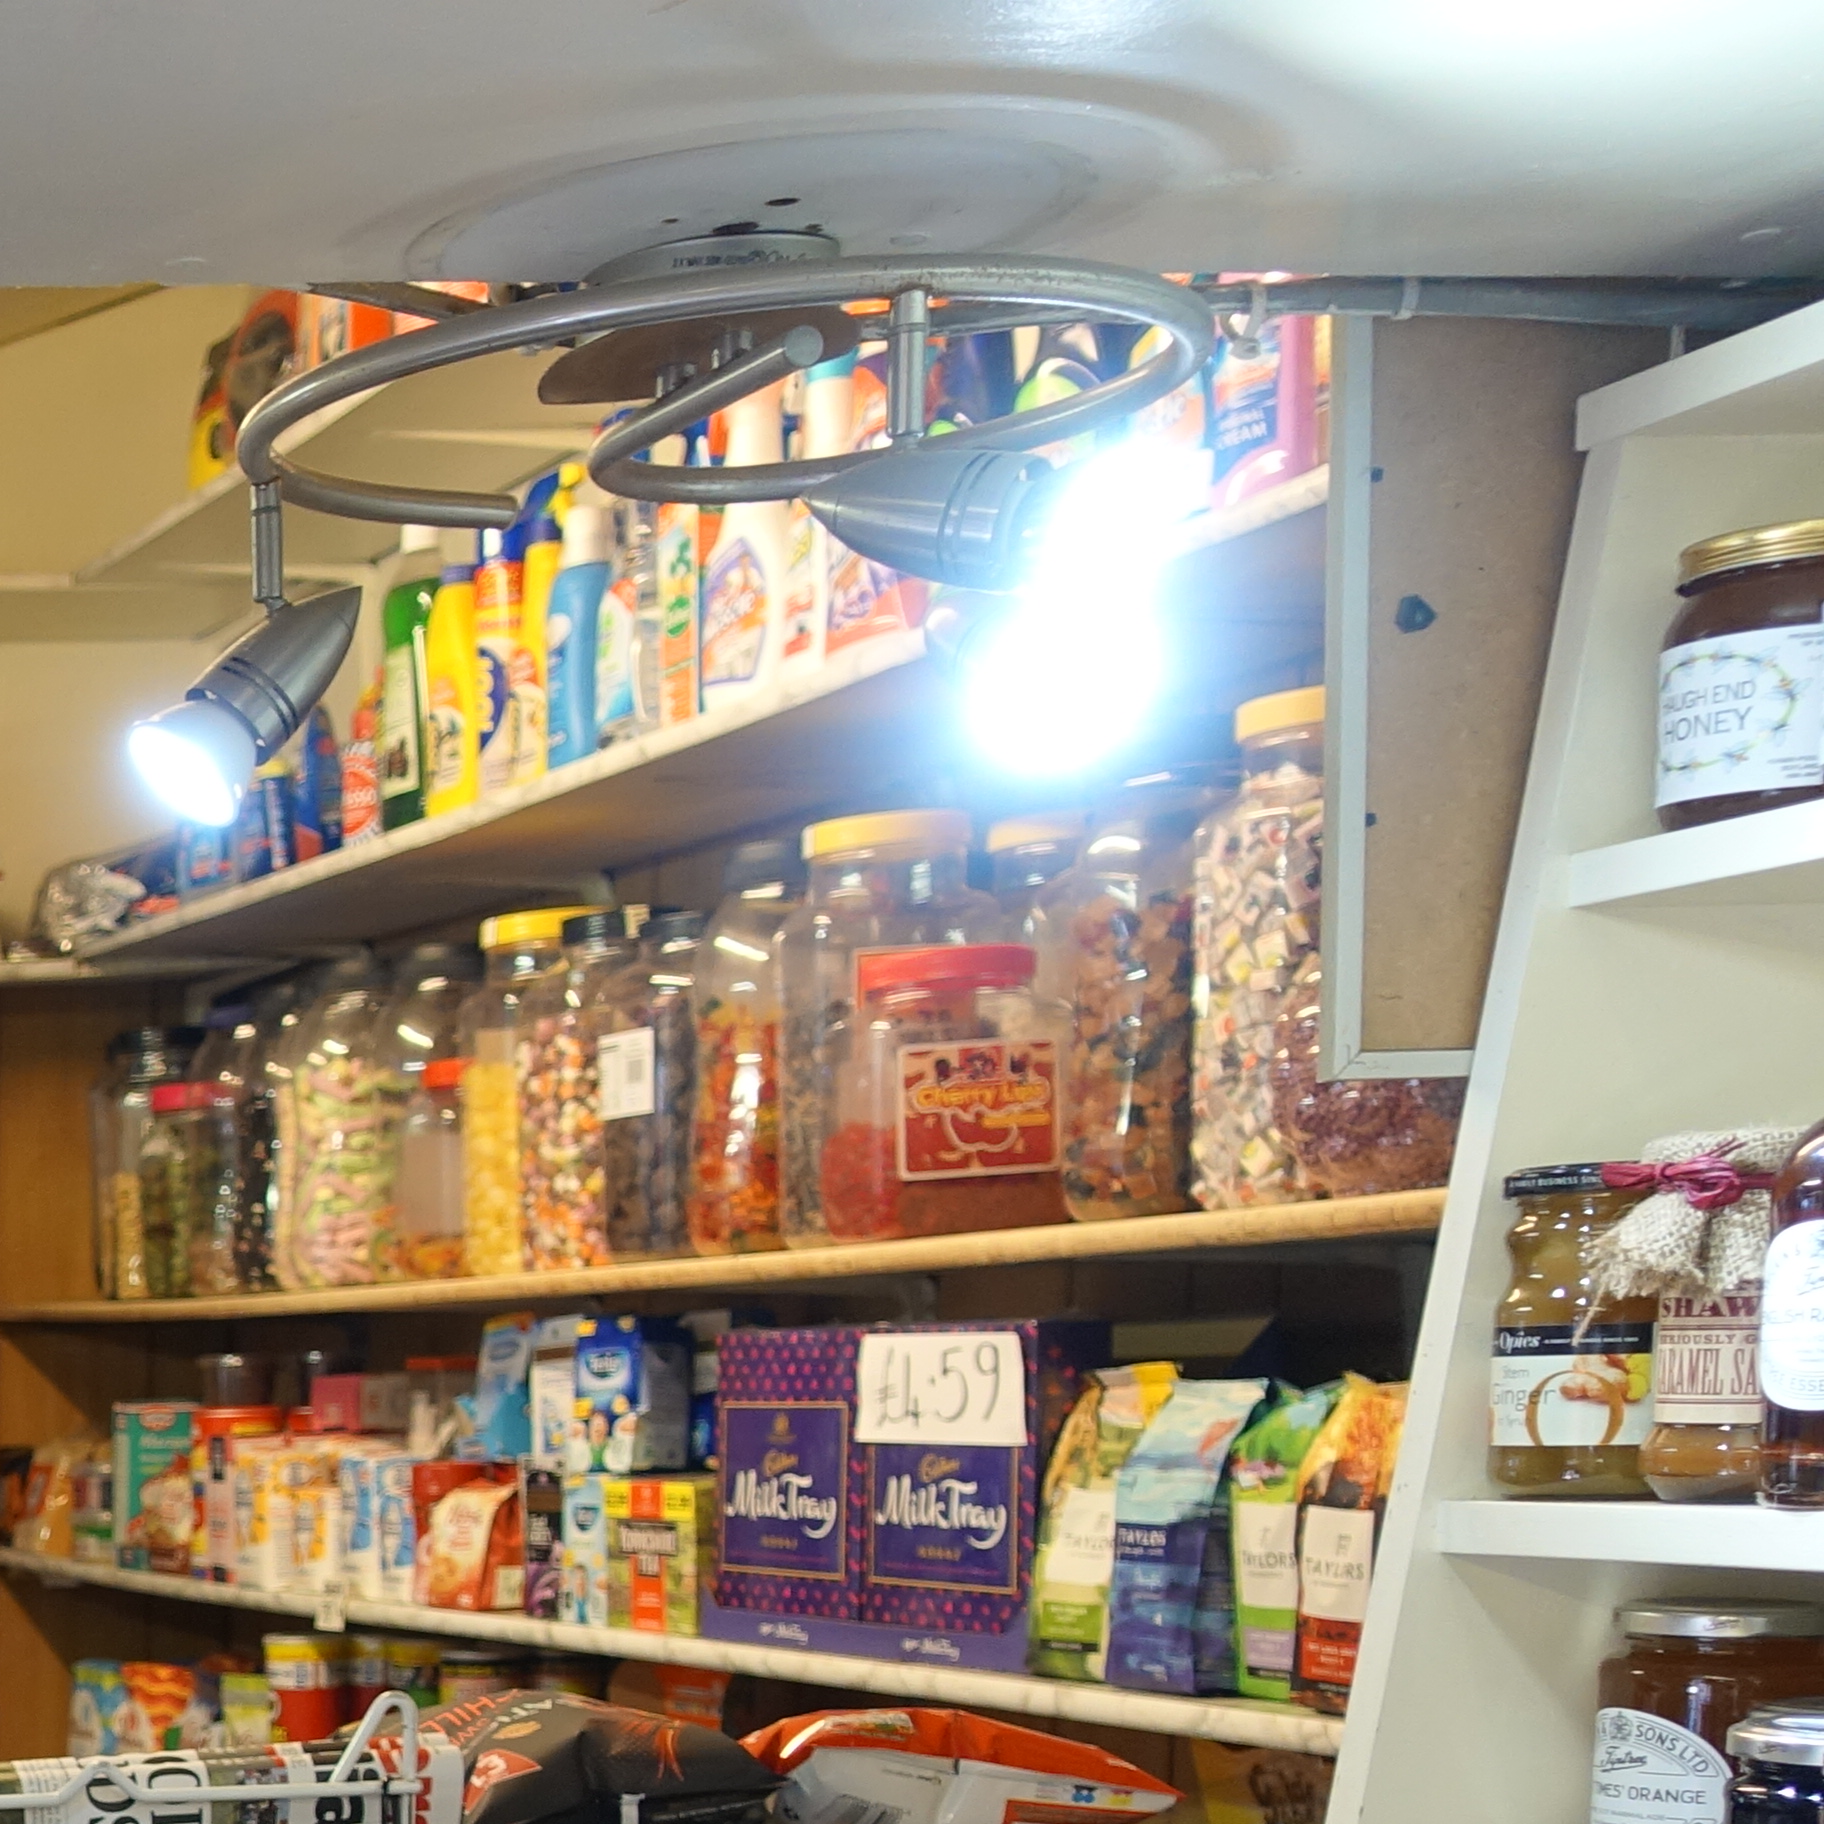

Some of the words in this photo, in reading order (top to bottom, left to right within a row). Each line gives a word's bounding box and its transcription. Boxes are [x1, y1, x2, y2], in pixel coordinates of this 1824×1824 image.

[1712, 680, 1756, 704] END
[1663, 705, 1754, 746] HONEY
[1491, 1386, 1557, 1411] Ginger
[1060, 1530, 1116, 1552] TAYLOR
[1636, 1724, 1678, 1752] SONS
[1678, 1743, 1710, 1775] LTD
[1627, 1787, 1708, 1806] ORANGE
